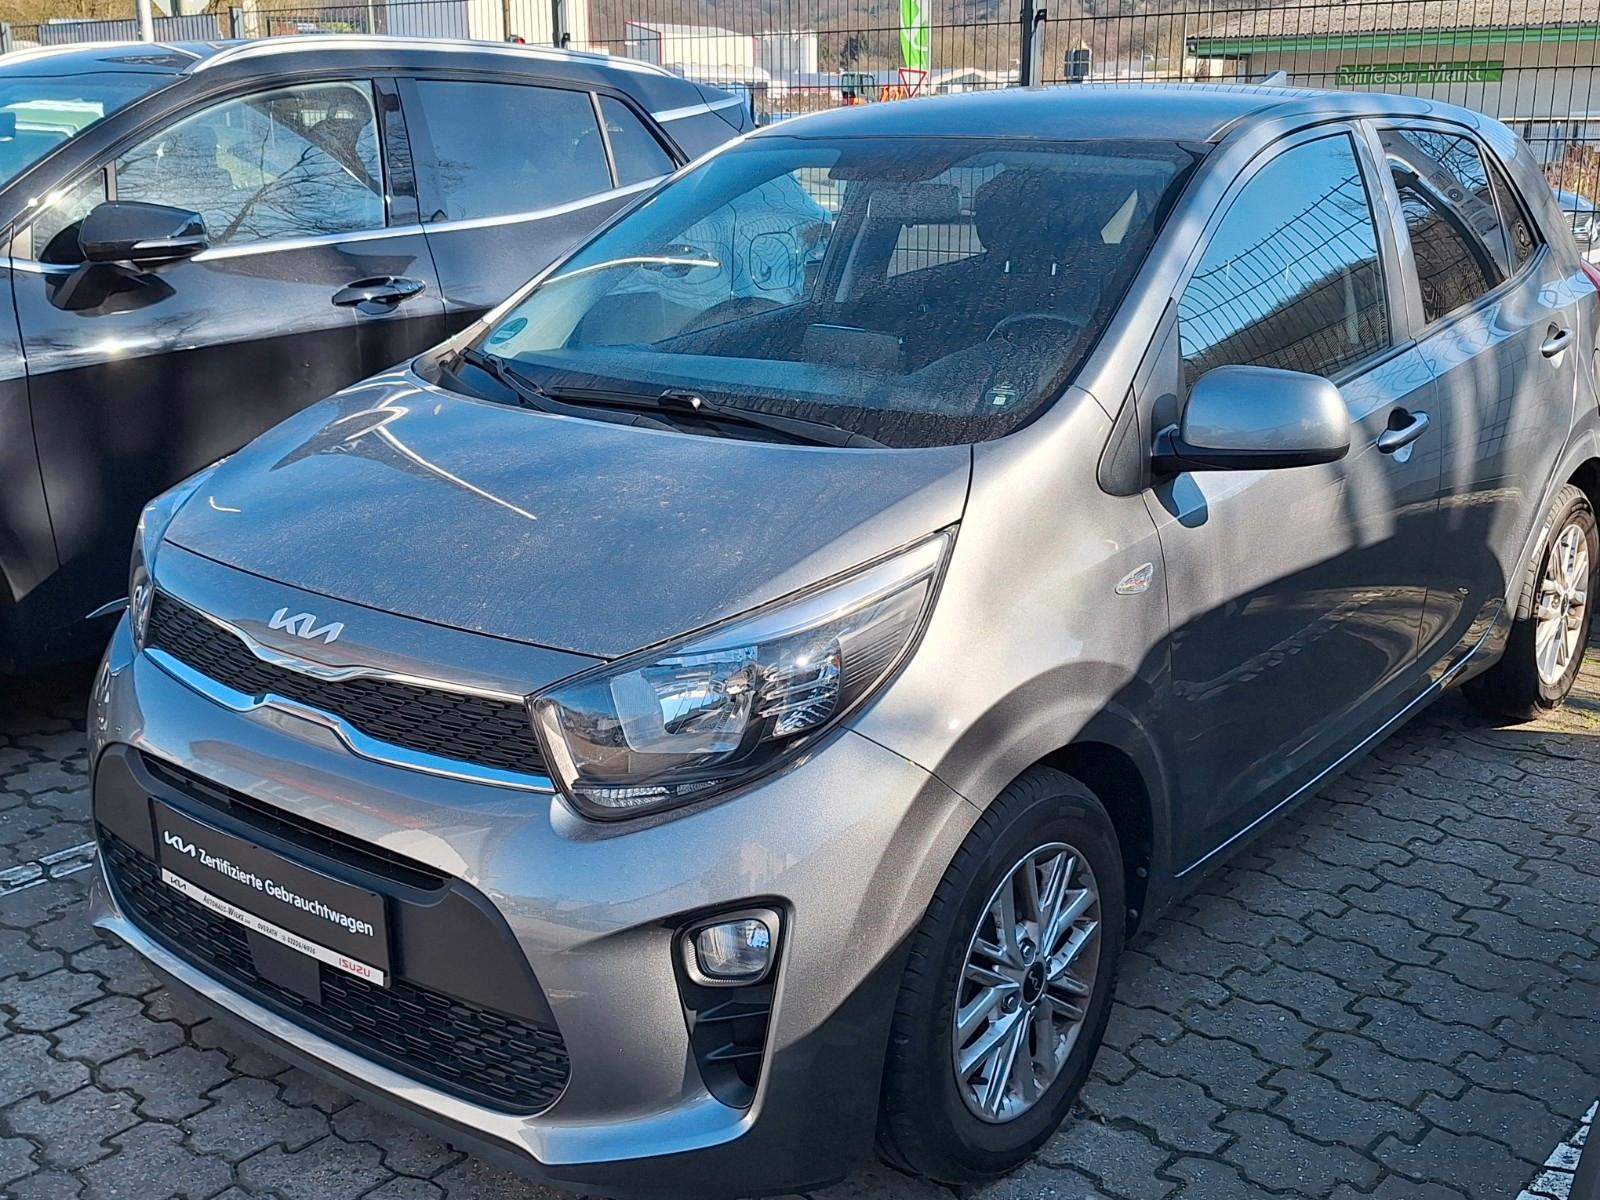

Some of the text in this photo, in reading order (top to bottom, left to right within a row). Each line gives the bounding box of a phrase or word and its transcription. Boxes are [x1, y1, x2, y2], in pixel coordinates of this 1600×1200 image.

[268, 607, 345, 645] KIA
[164, 830, 374, 937] KIA Zertifizierte Gebrauchtwagen
[338, 957, 371, 978] ISUZU
